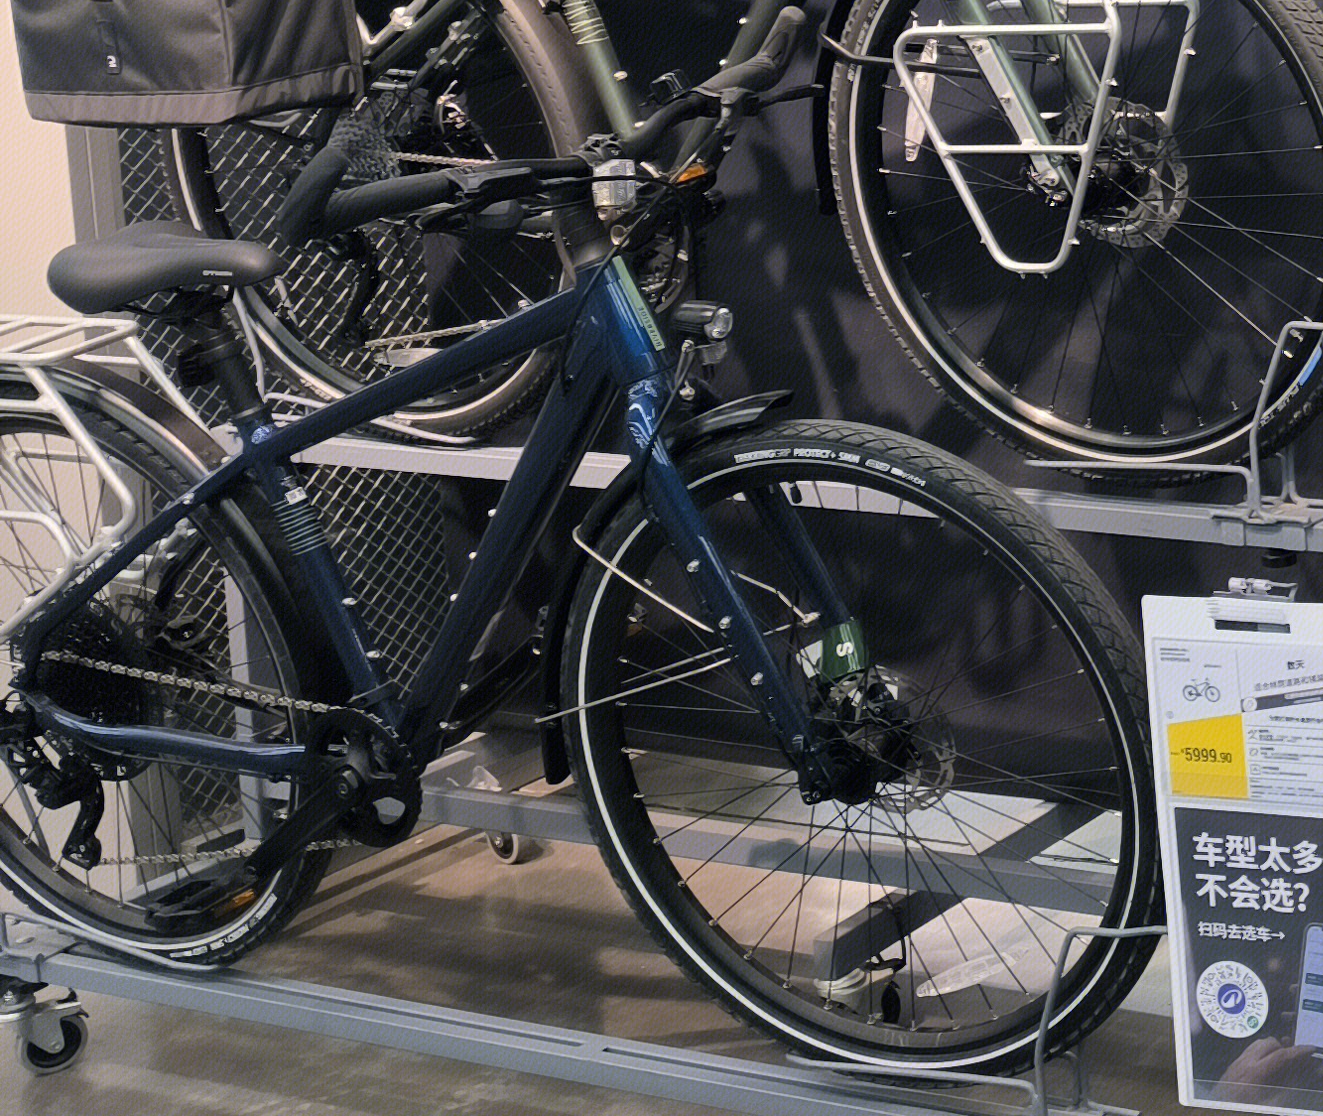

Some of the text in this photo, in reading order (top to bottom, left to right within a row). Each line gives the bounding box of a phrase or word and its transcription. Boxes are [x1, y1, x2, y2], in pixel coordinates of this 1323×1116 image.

[1195, 873, 1311, 914] 不会选?
[1197, 920, 1273, 943] 扫码去选车
